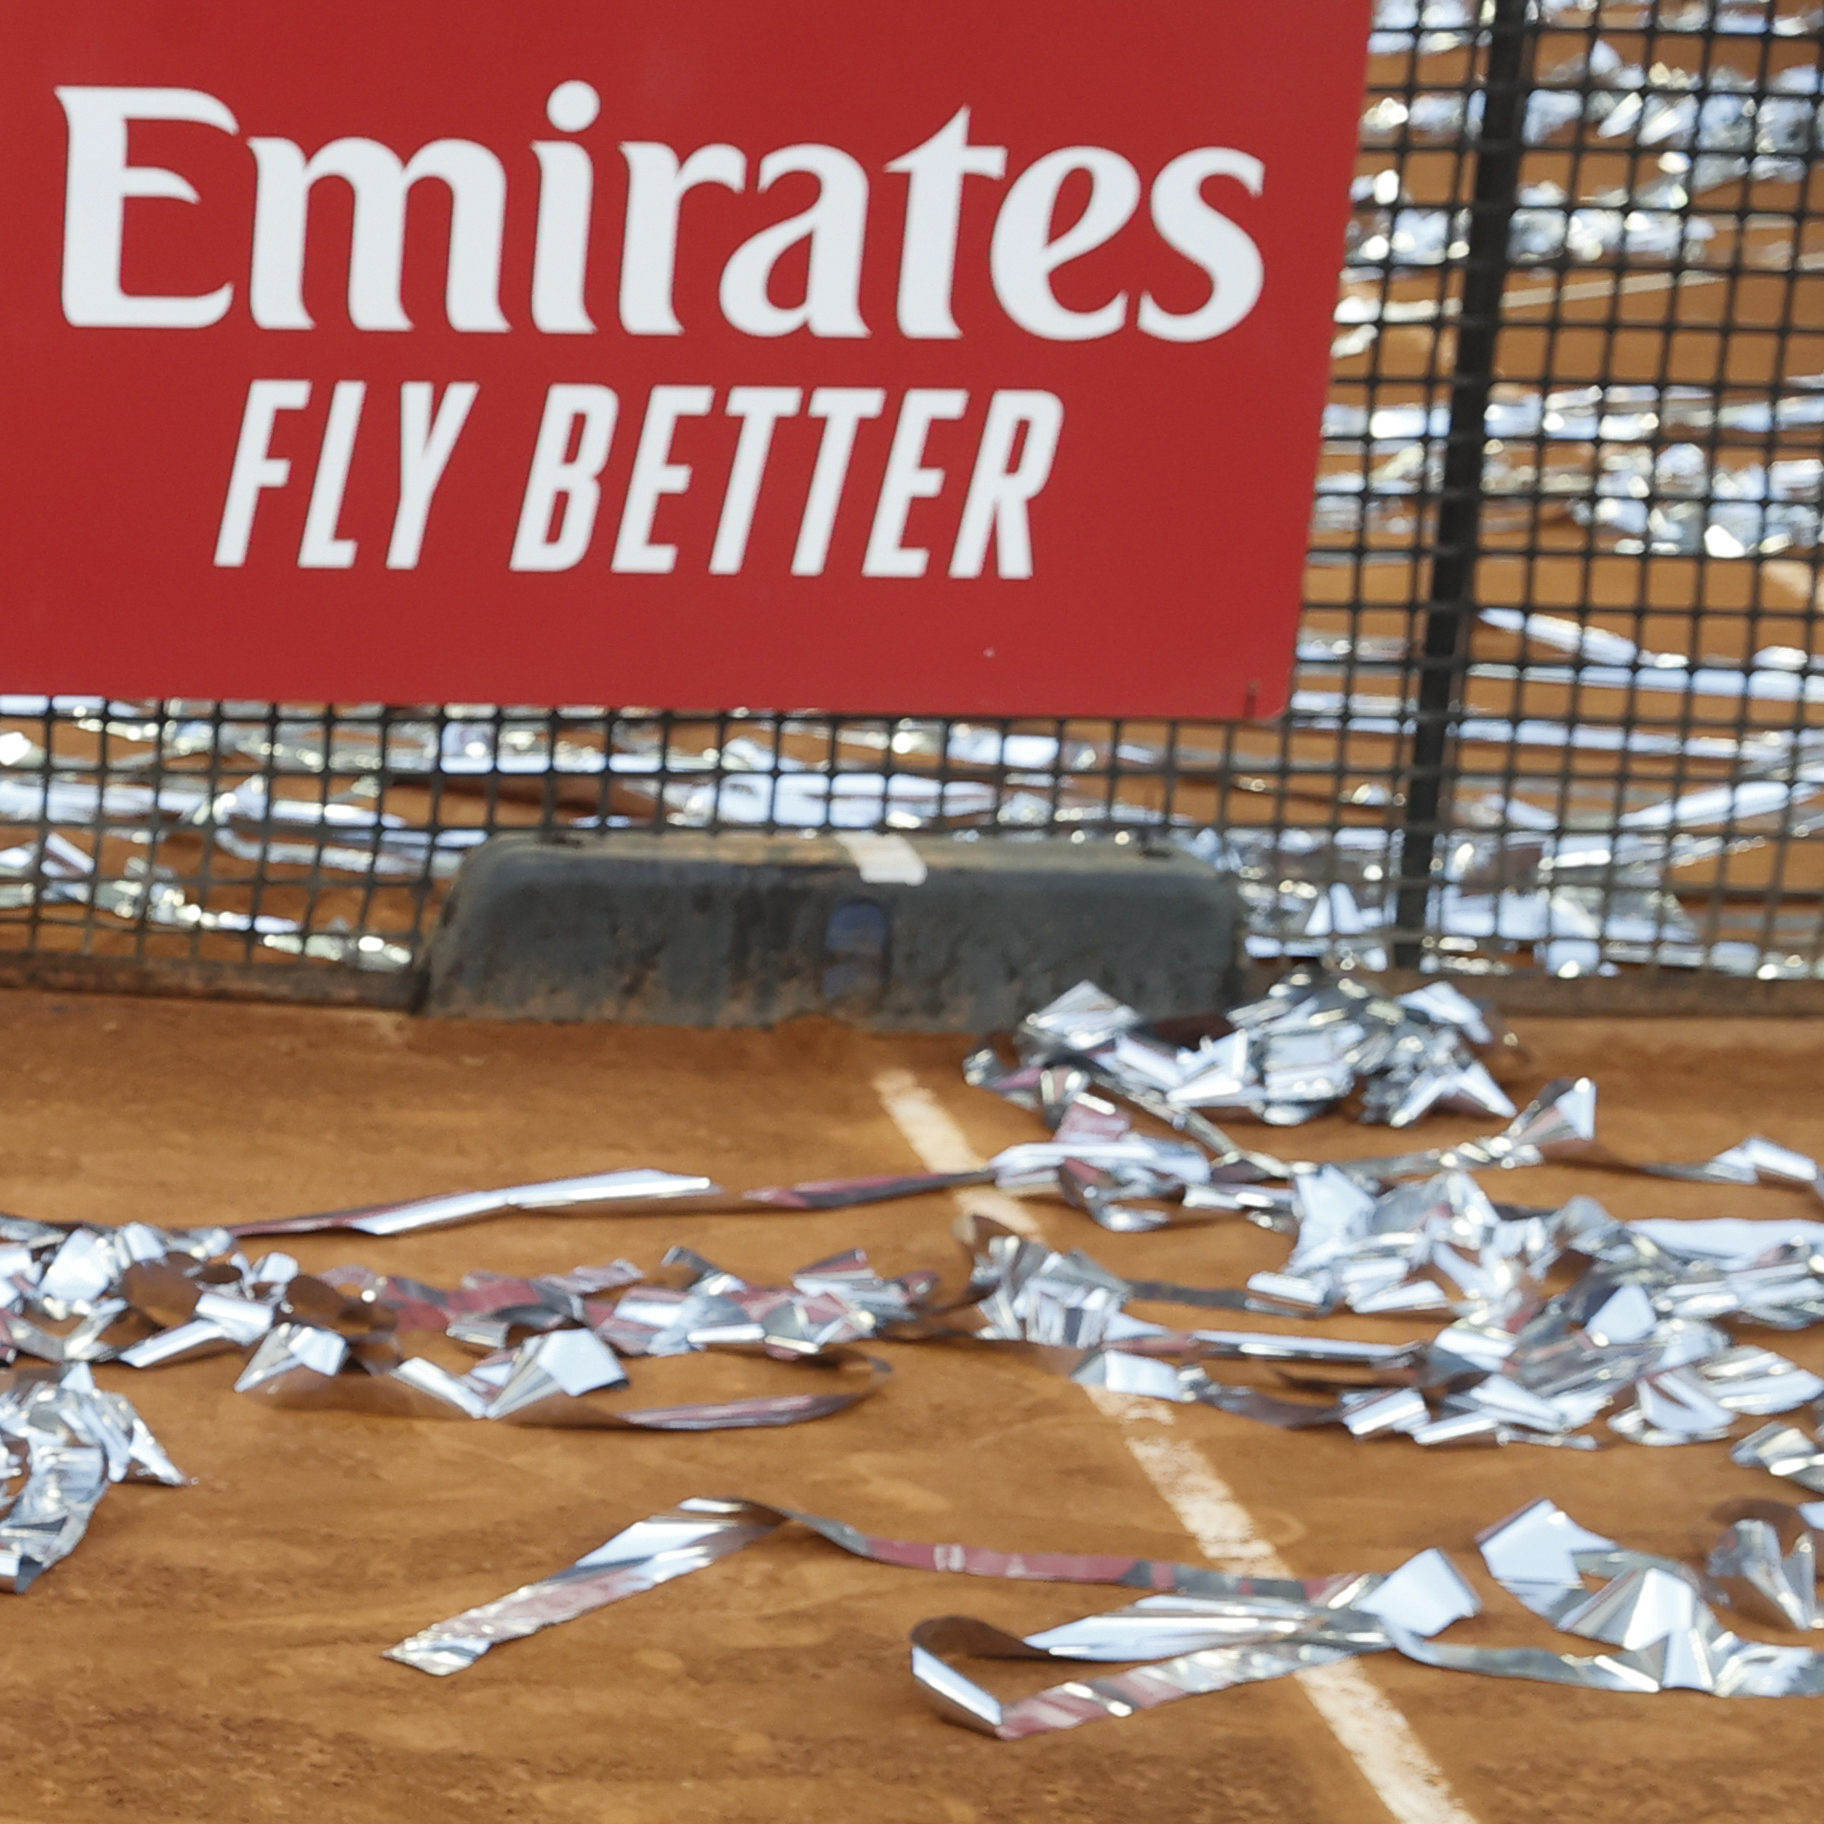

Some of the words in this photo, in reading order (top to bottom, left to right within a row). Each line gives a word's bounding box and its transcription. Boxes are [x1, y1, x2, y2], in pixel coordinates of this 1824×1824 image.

[54, 80, 1266, 343] Emirates
[214, 379, 479, 570] FLY
[509, 383, 1065, 580] BETTER
